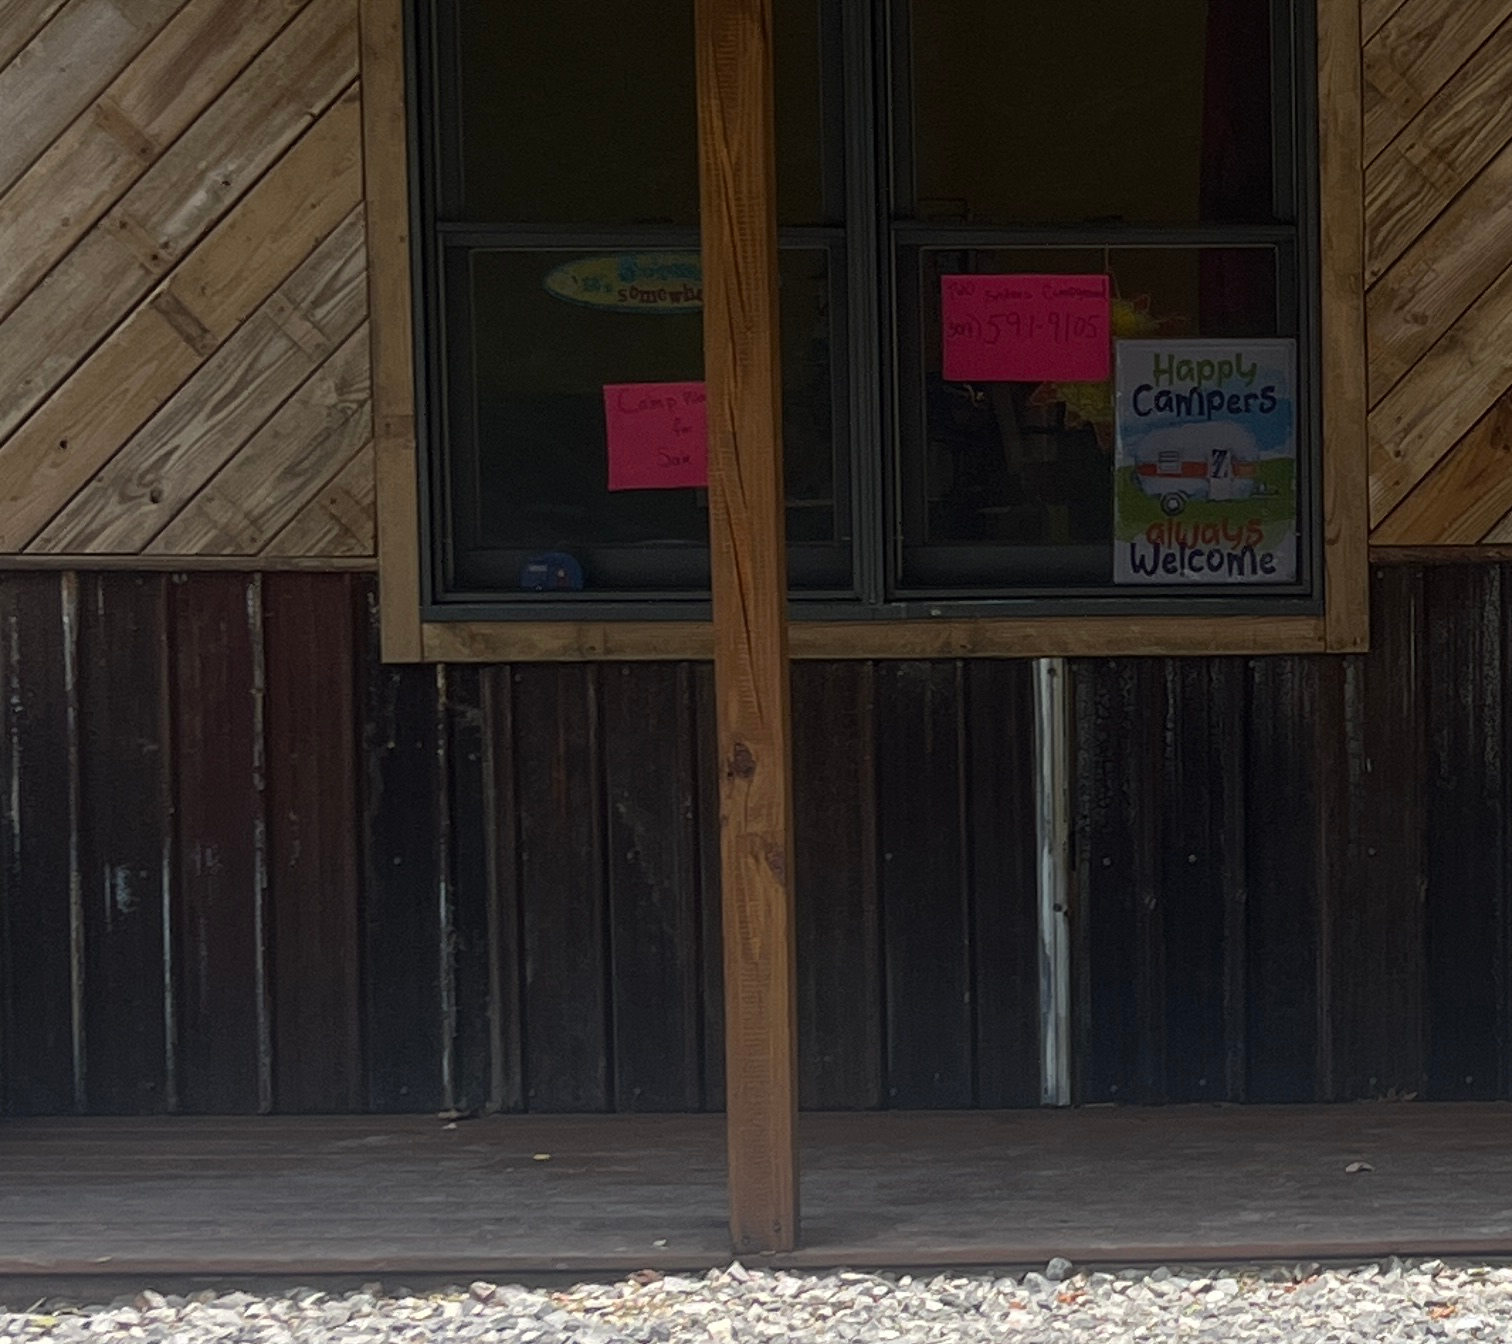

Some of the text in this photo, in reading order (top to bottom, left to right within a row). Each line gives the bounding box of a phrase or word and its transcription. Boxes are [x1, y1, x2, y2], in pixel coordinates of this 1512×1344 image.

[616, 283, 702, 303] somewhe
[1152, 352, 1257, 387] Happy
[1132, 383, 1278, 420] Campers
[1145, 518, 1264, 550] always
[1130, 542, 1277, 577] Welcome
